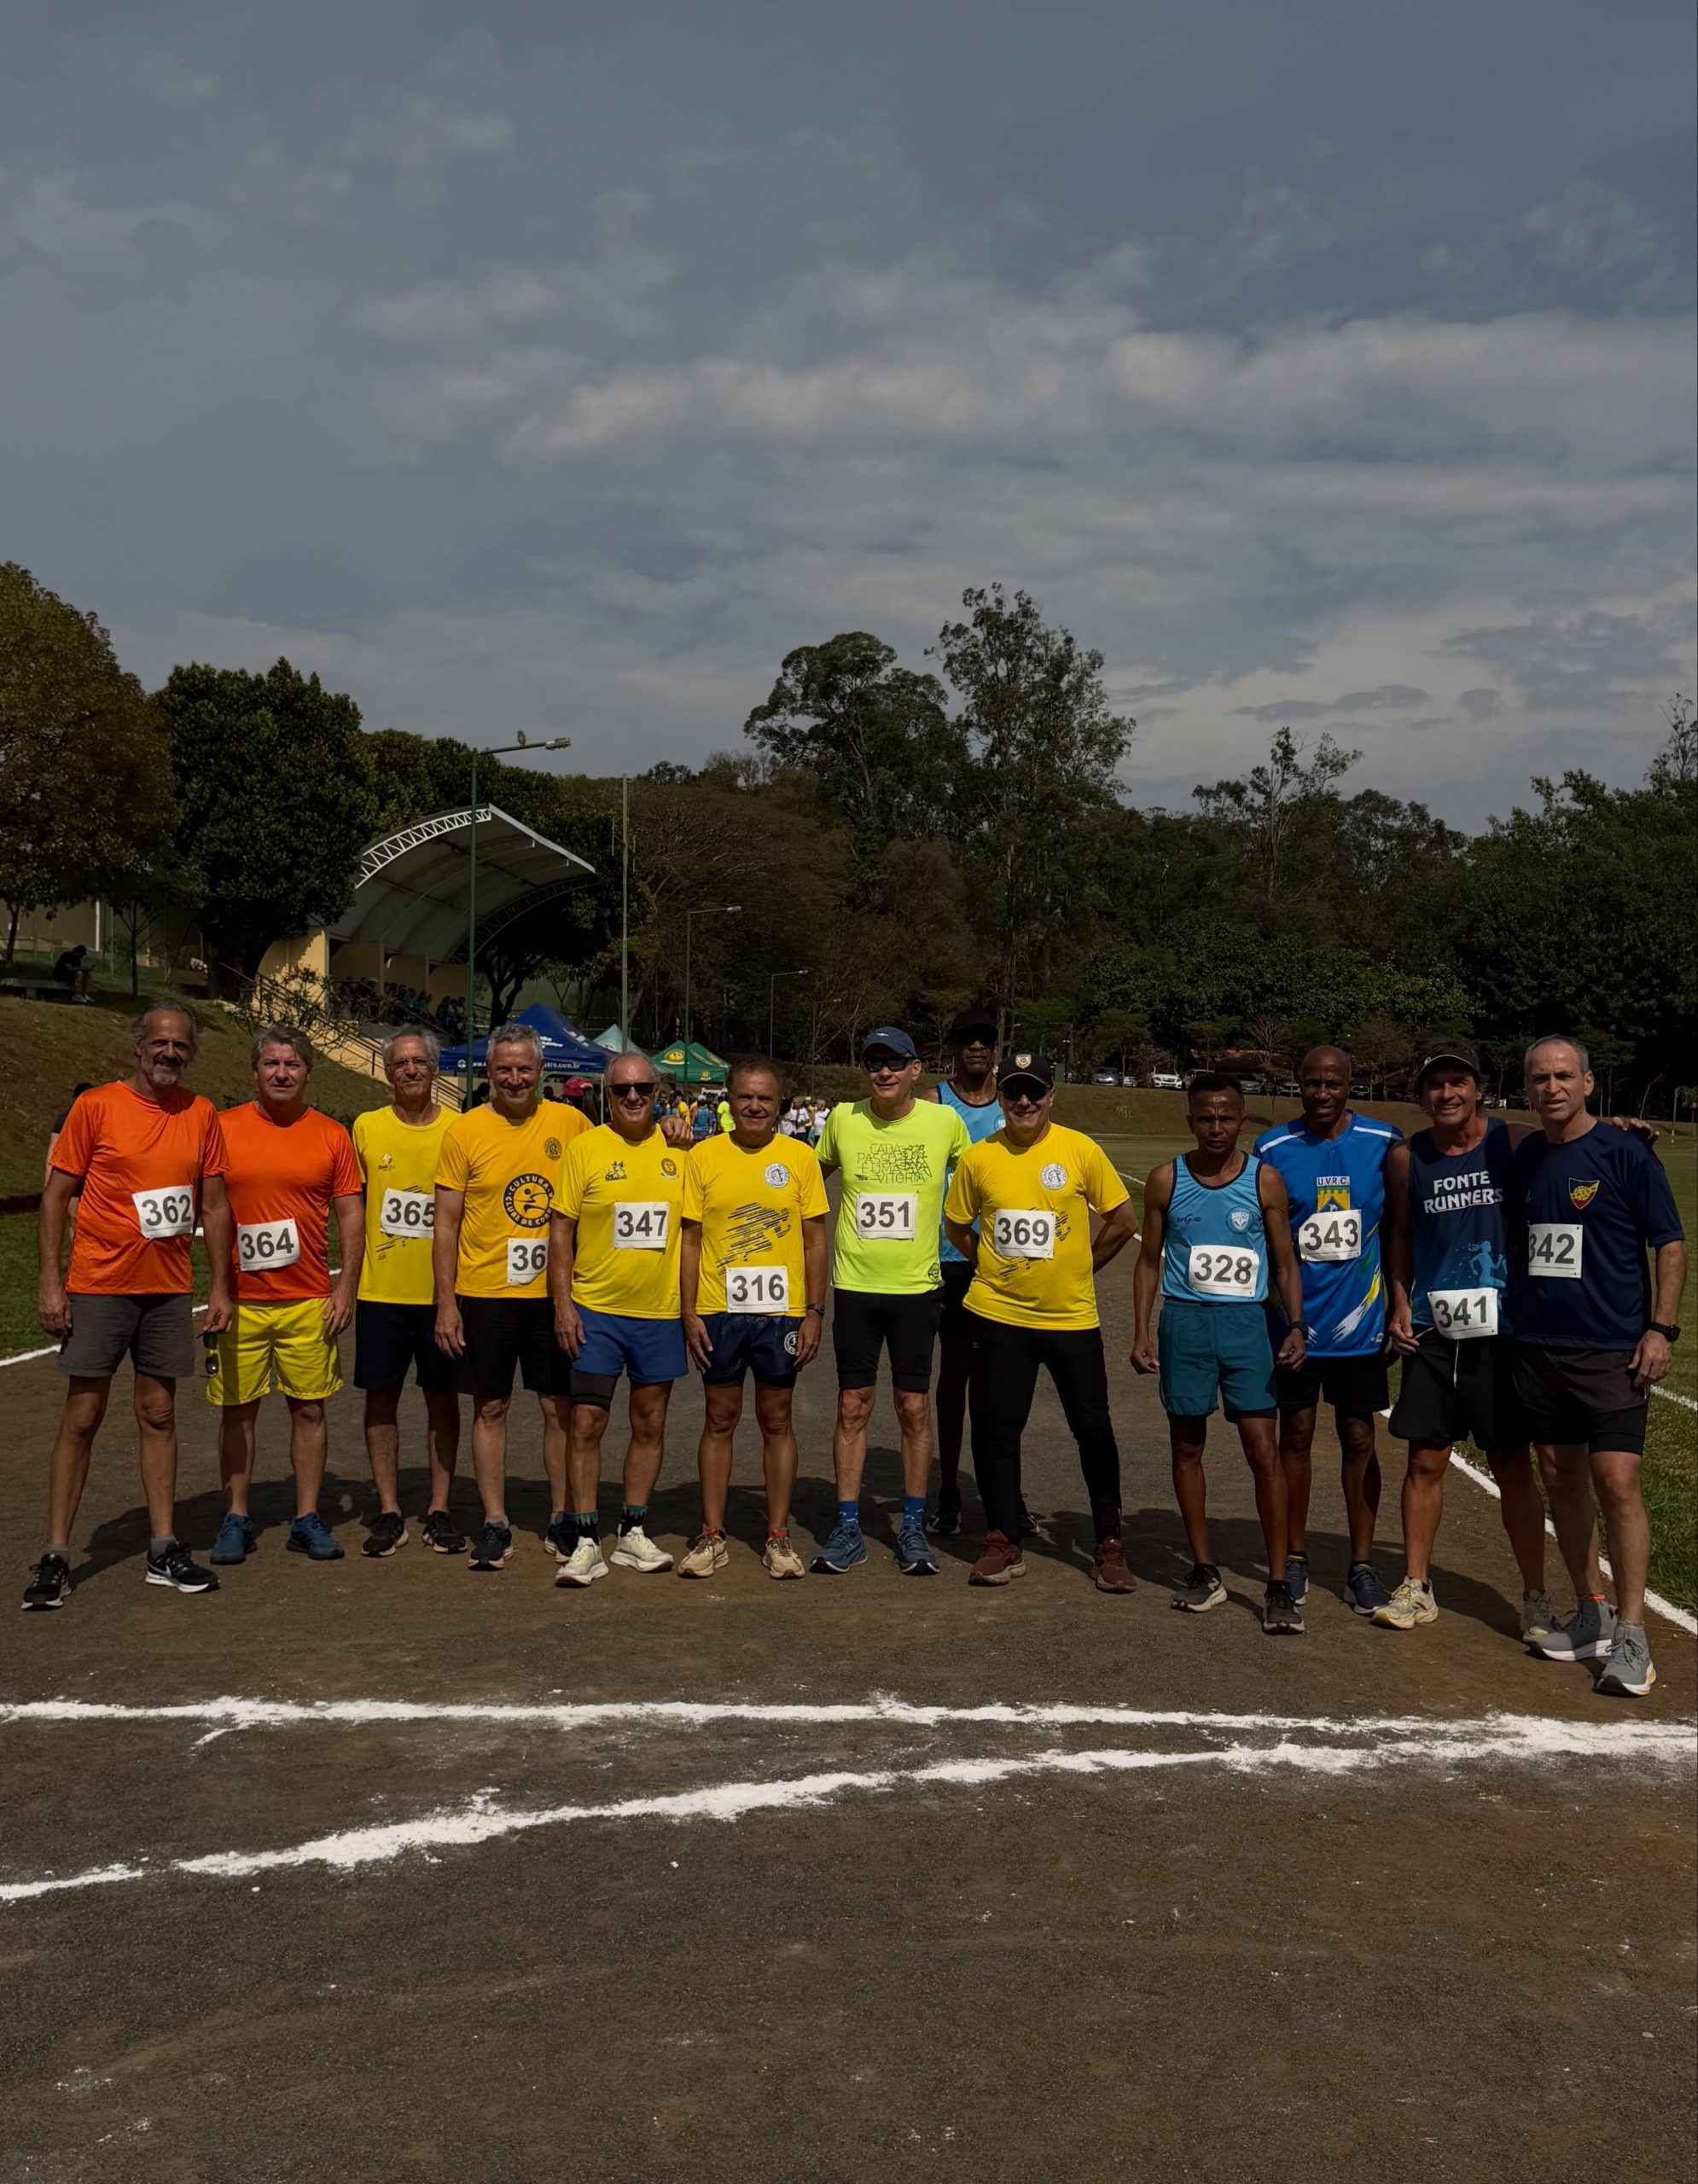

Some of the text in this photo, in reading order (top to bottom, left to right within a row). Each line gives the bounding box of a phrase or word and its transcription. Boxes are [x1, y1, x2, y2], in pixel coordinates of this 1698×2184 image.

[856, 1153, 897, 1165] PASSO
[869, 1142, 901, 1155] CADA
[1433, 1170, 1491, 1194] FONTE
[142, 1194, 192, 1227] 362
[386, 1198, 435, 1227] 365
[860, 1201, 910, 1228] 351
[1423, 1188, 1504, 1215] RUNNERS
[520, 1217, 533, 1226] DE
[618, 1210, 667, 1237] 347
[997, 1217, 1050, 1246] 369
[1304, 1218, 1358, 1251] 343
[240, 1227, 295, 1260] 364
[1529, 1233, 1575, 1264] 342
[512, 1245, 546, 1271] 36
[1194, 1252, 1253, 1284] 328
[731, 1275, 785, 1302] 316
[1433, 1295, 1487, 1327] 341
